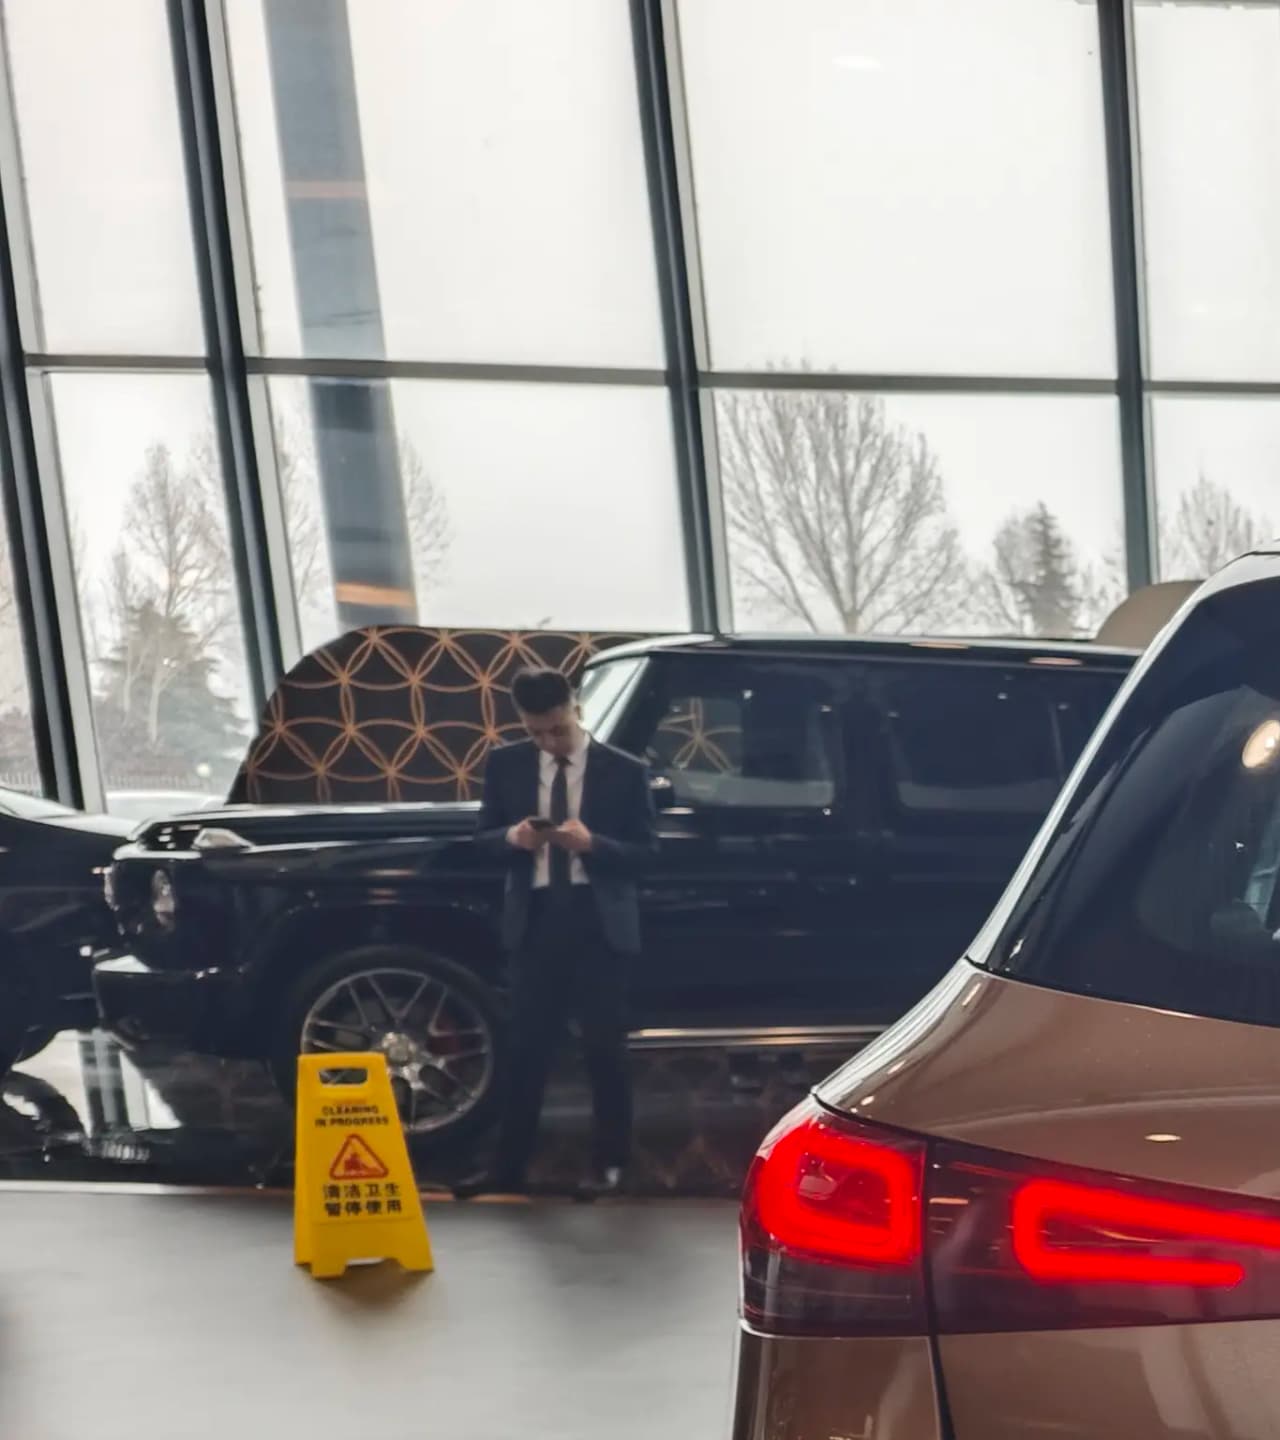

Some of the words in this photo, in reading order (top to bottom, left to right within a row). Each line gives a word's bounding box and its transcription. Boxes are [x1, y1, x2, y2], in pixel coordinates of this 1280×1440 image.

[323, 1105, 379, 1115] CLEANING
[316, 1118, 327, 1127] IN
[330, 1116, 388, 1127] PROGRESS
[323, 1183, 400, 1199] 清洁卫生
[324, 1200, 402, 1216] 暂停使用
